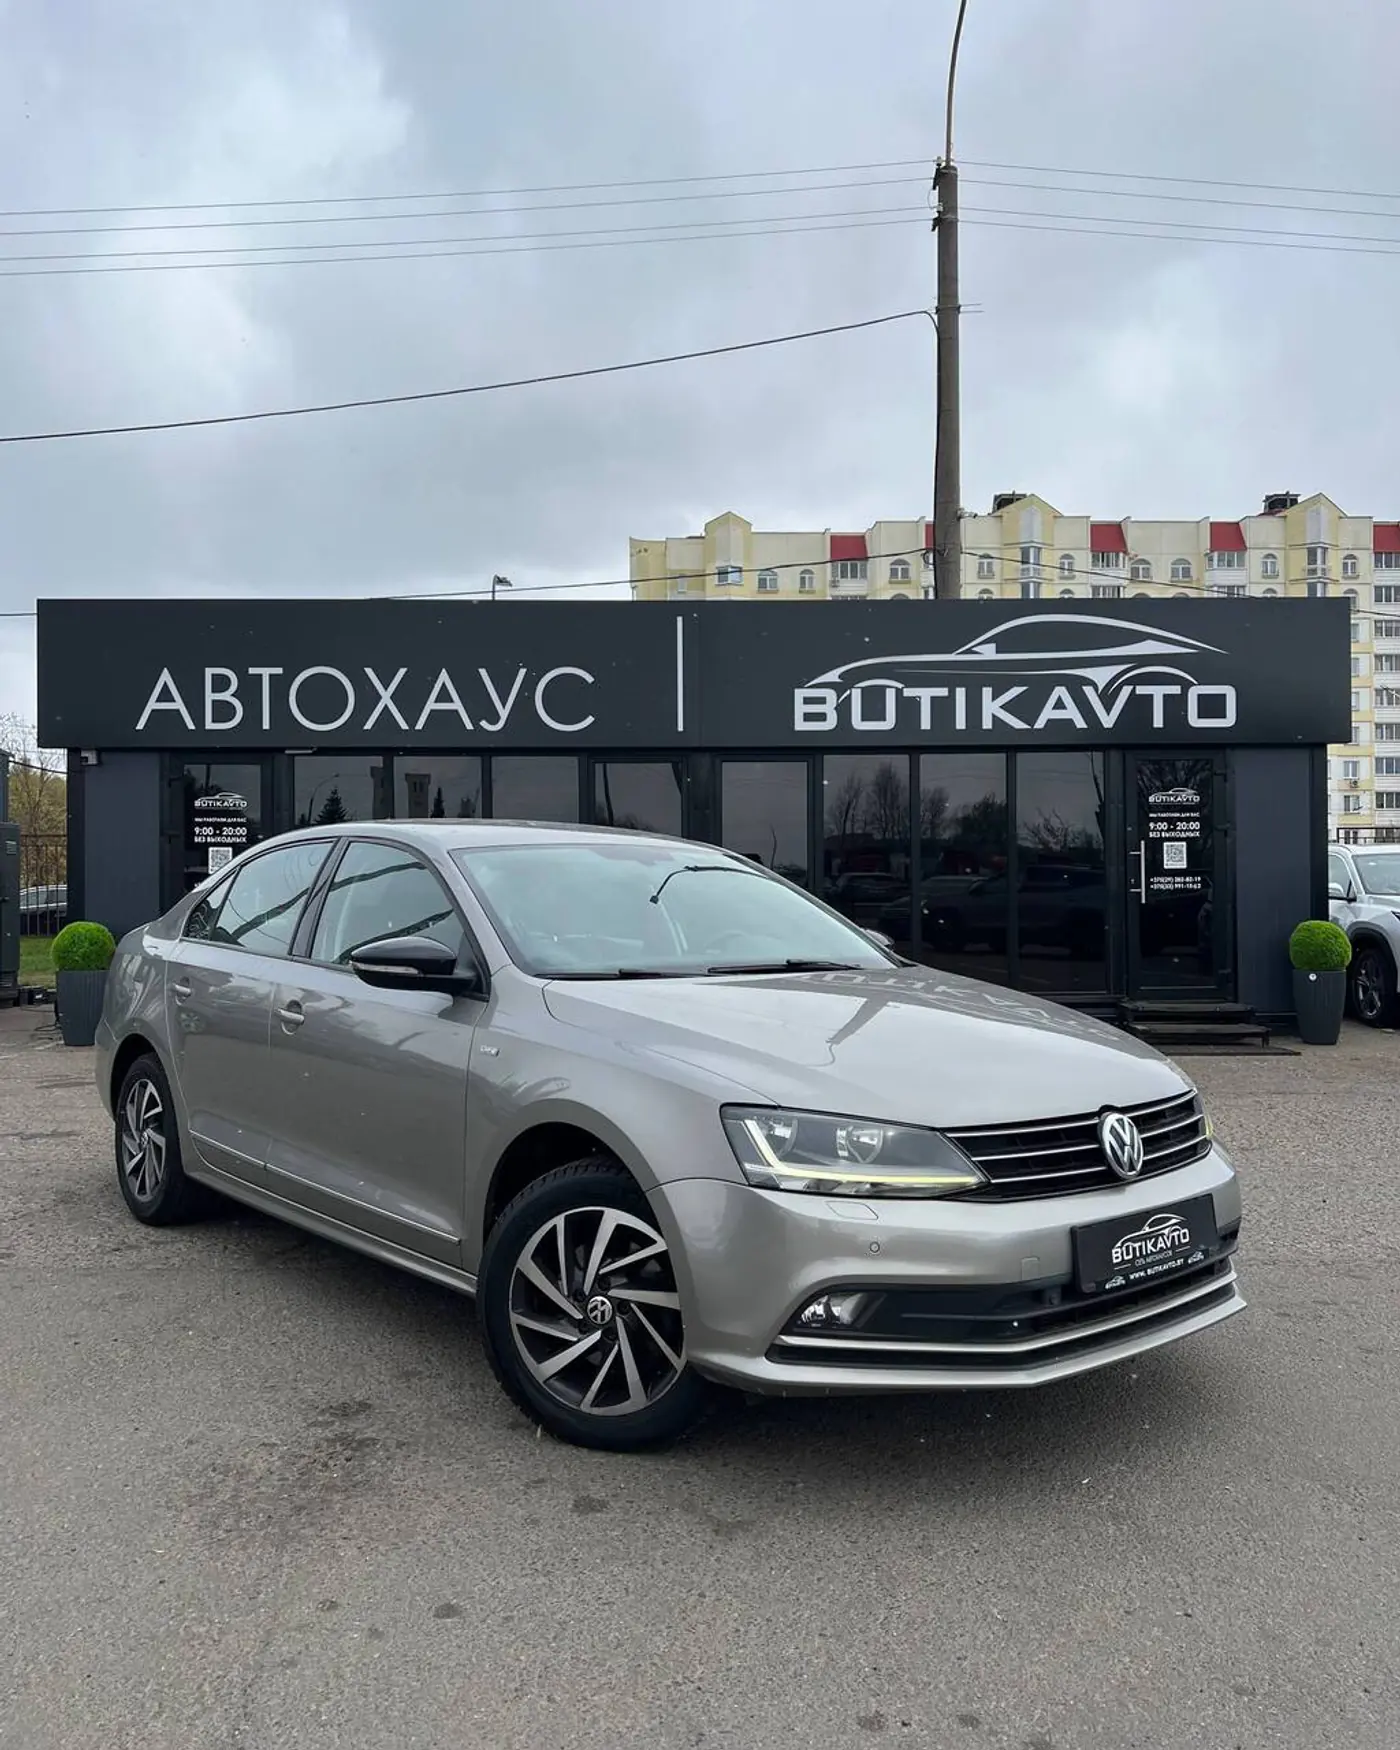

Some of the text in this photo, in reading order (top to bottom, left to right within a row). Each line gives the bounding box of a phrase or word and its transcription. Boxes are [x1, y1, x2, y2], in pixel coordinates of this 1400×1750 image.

[135, 665, 597, 733] АВТОХАУС
[793, 684, 1237, 732] BUTIKAVTO
[194, 826, 214, 836] 9:00
[222, 826, 247, 836] 20:00
[1149, 821, 1168, 830] 9:00
[1175, 821, 1200, 830] 20:00
[1111, 1227, 1190, 1264] BUTIKAVTO
